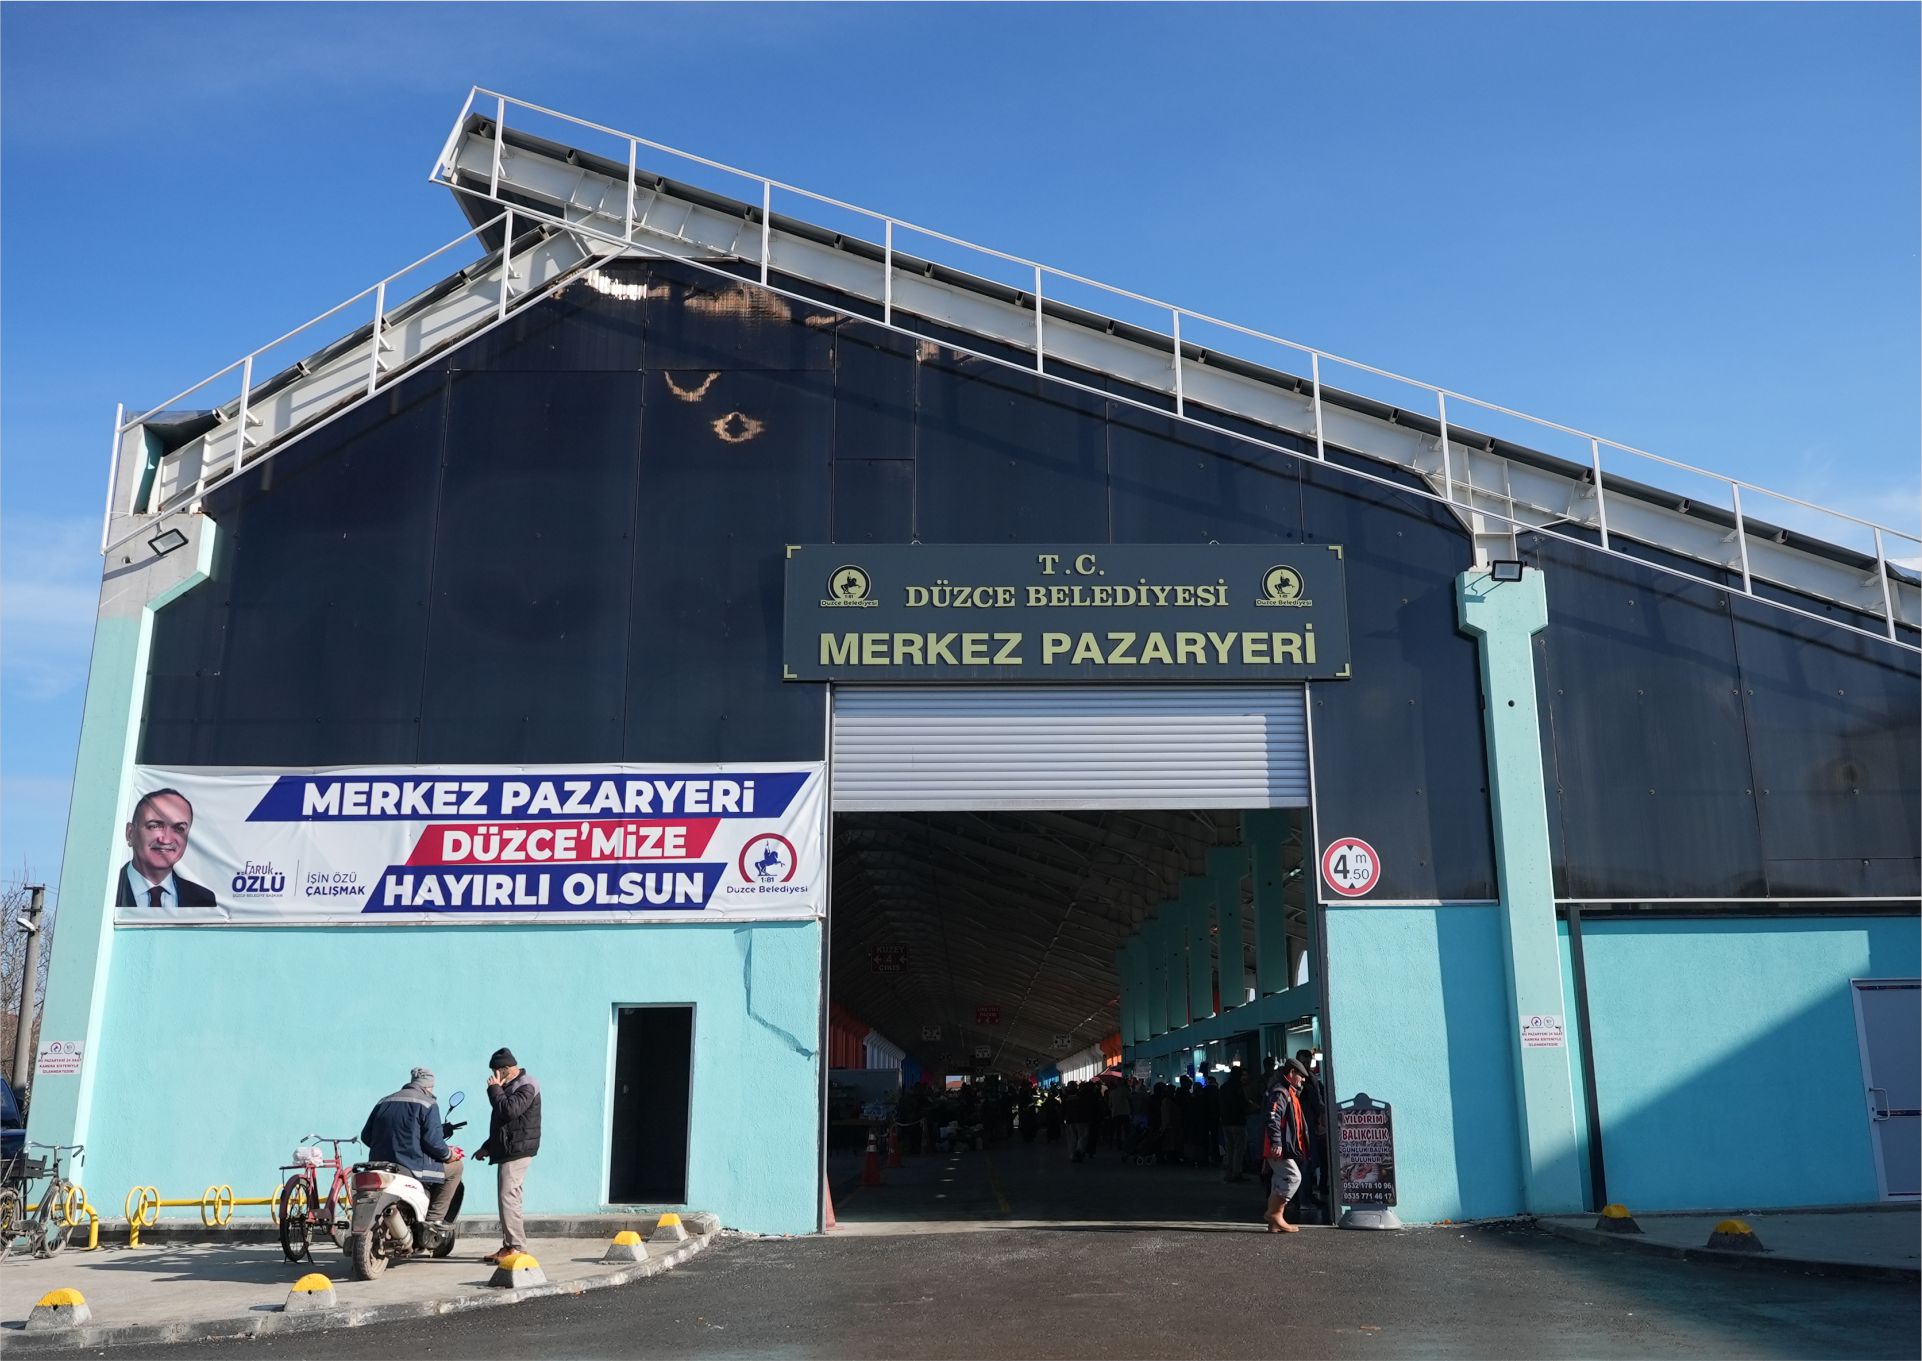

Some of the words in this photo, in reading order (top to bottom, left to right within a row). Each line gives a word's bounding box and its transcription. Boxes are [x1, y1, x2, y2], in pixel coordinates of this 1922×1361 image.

[905, 579, 1016, 608] DÜZCE
[1026, 578, 1230, 607] BELEDİYESİ
[819, 632, 1023, 666] MERKEZ
[1042, 623, 1317, 666] PAZARYERİ
[302, 782, 489, 816] MERKEZ
[500, 780, 755, 815] PAZARYERİ
[231, 871, 286, 893] ÖZLÜ
[306, 872, 330, 885] İŞİN
[332, 871, 357, 884] ÖZÜ
[305, 885, 366, 897] ÇALIŞMAK
[383, 873, 550, 907] HAYIRLI
[562, 872, 704, 907] OLSUN
[759, 884, 808, 895] Belediyesi
[1344, 1114, 1384, 1125] YILDIRIM
